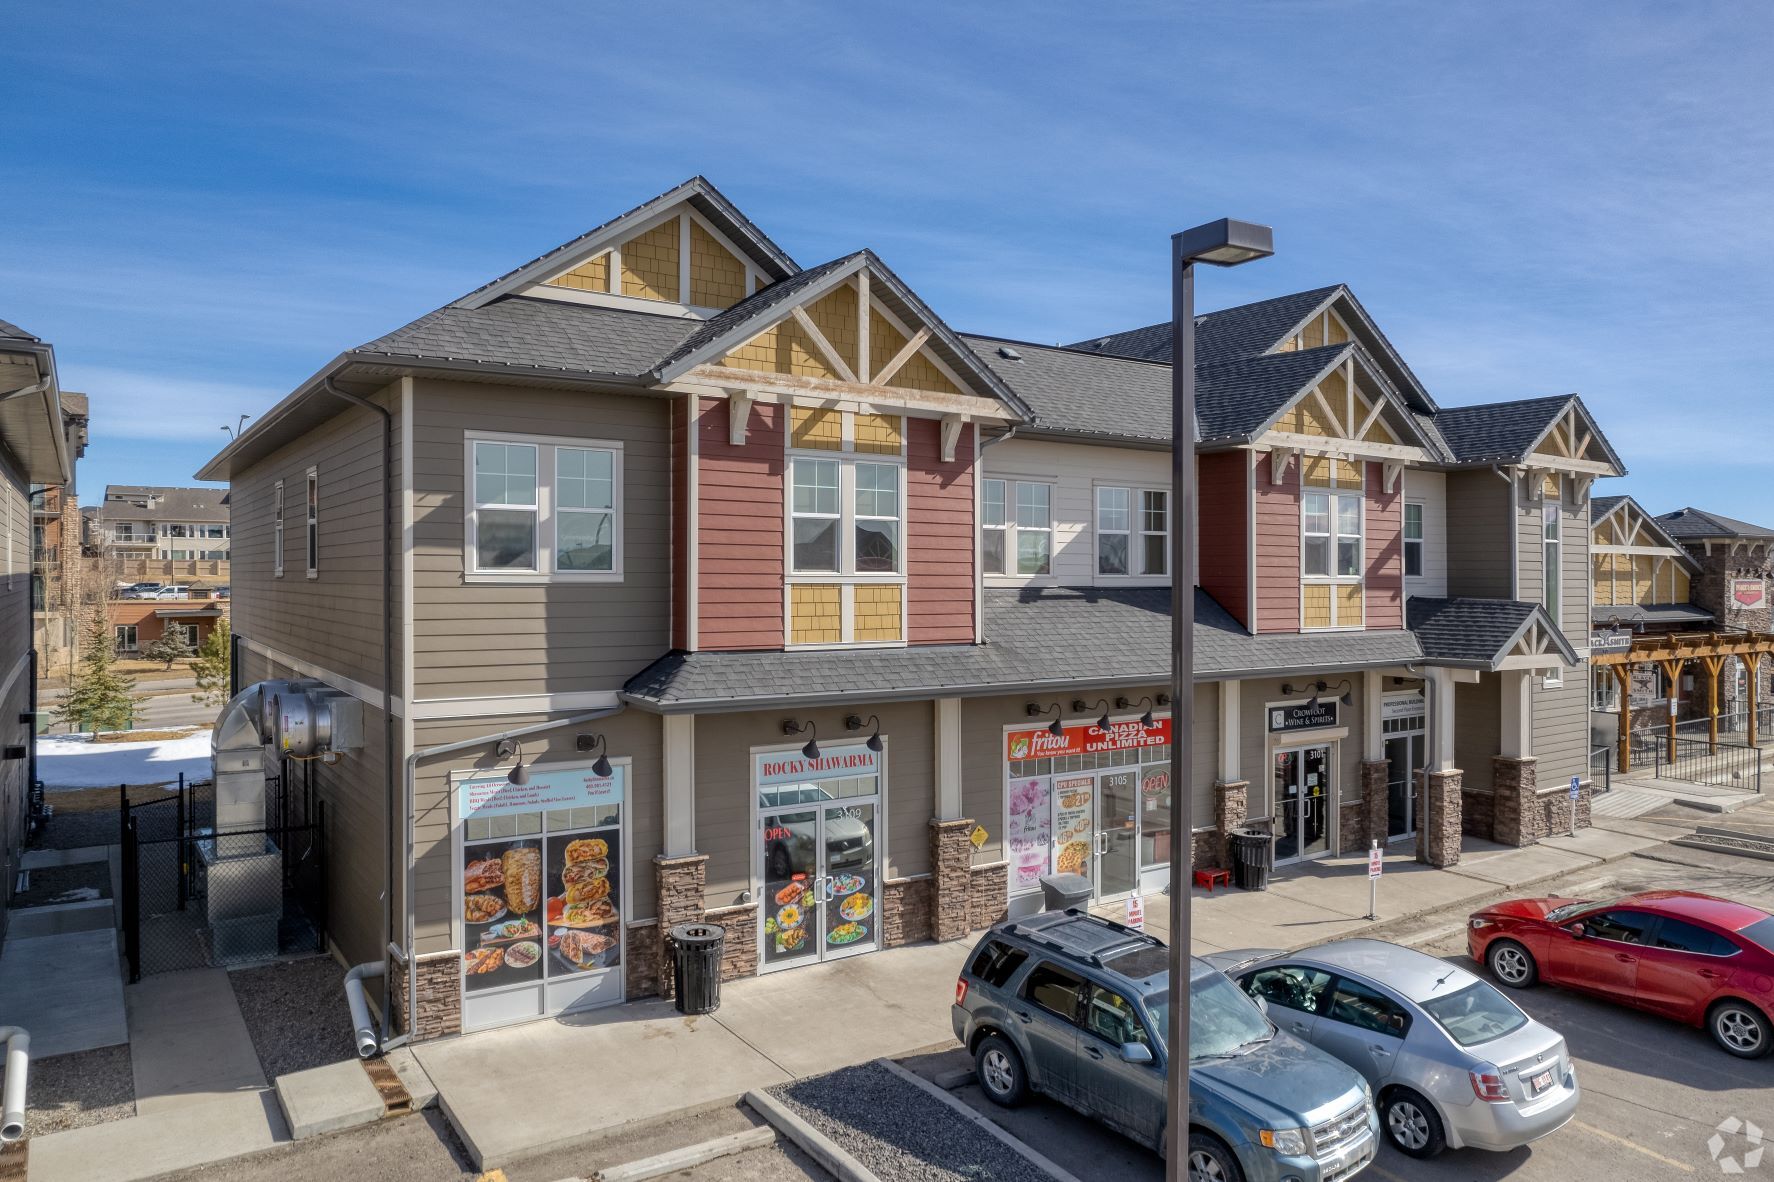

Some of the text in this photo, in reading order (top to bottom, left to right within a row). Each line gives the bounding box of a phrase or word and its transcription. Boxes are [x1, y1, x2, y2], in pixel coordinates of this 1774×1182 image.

[1305, 716, 1310, 725] &
[1311, 715, 1331, 724] SPIRITS
[1088, 720, 1163, 736] CNADIN
[1105, 729, 1148, 742] PIZZA
[1031, 731, 1071, 756] fritou
[1086, 735, 1165, 752] UNLIMITED
[1310, 750, 1324, 760] 3101
[763, 753, 874, 777] ROCKY SHAWARMA
[1109, 775, 1127, 787] 3105
[1143, 774, 1168, 793] OPEN
[837, 808, 862, 821] 3109
[764, 826, 792, 841] OPEN
[1132, 899, 1139, 909] 15
